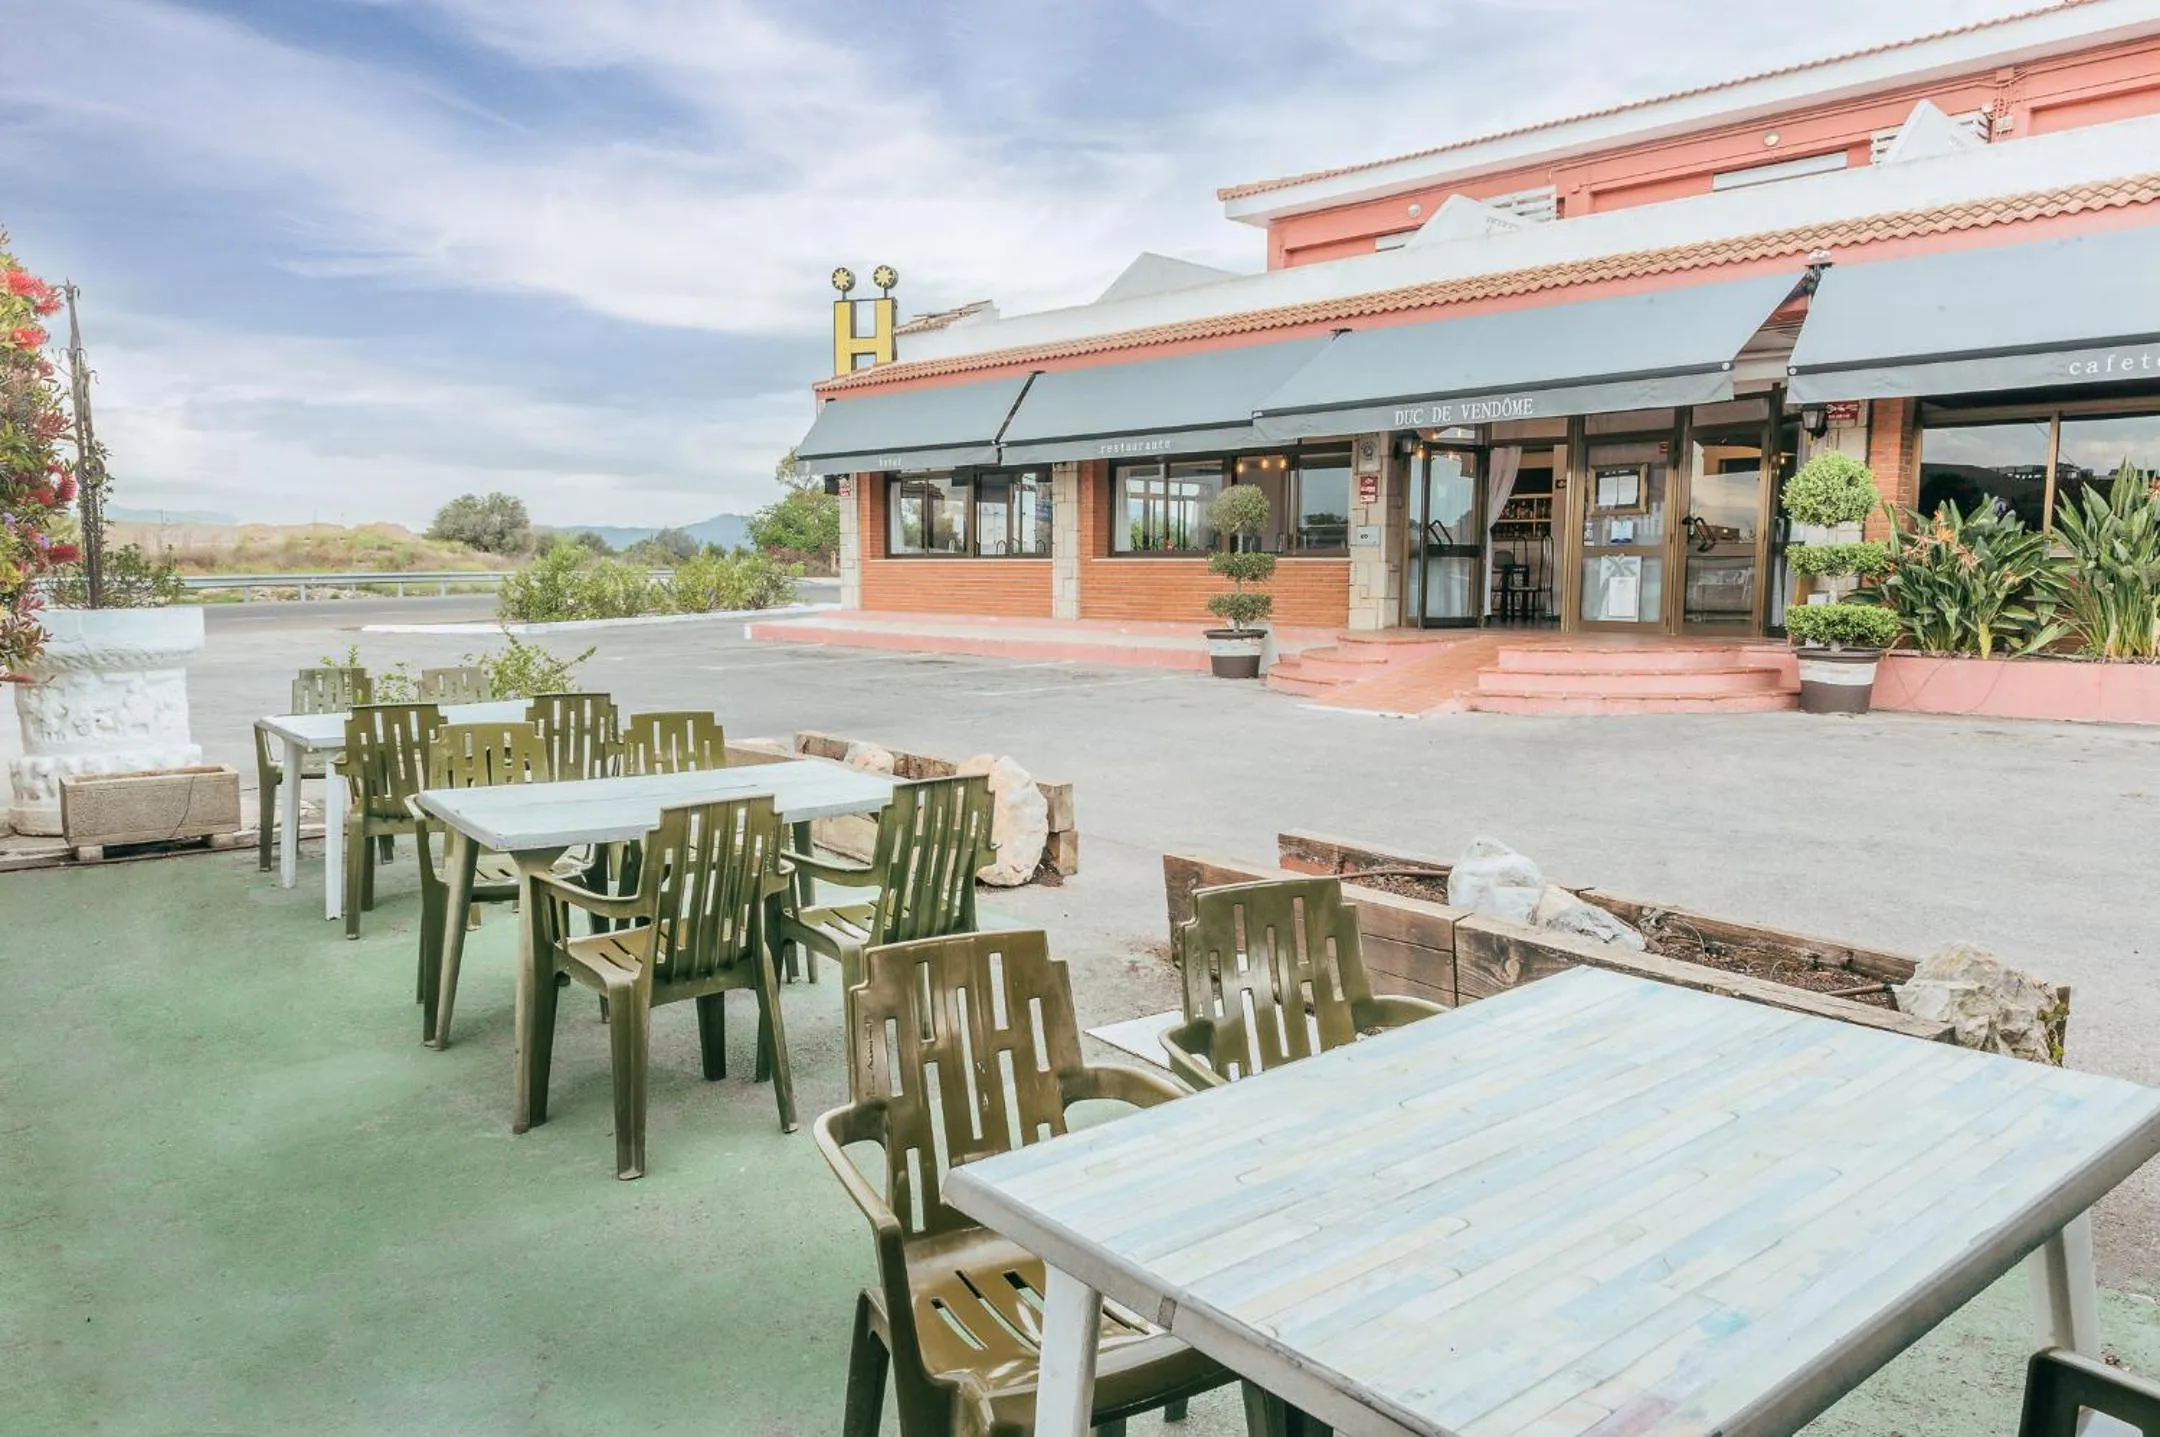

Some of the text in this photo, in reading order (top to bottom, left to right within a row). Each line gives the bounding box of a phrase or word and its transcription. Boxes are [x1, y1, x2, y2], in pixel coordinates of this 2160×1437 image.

[834, 299, 893, 377] H
[2068, 353, 2160, 376] cafet
[1394, 397, 1533, 426] DUC DE VENDÔME
